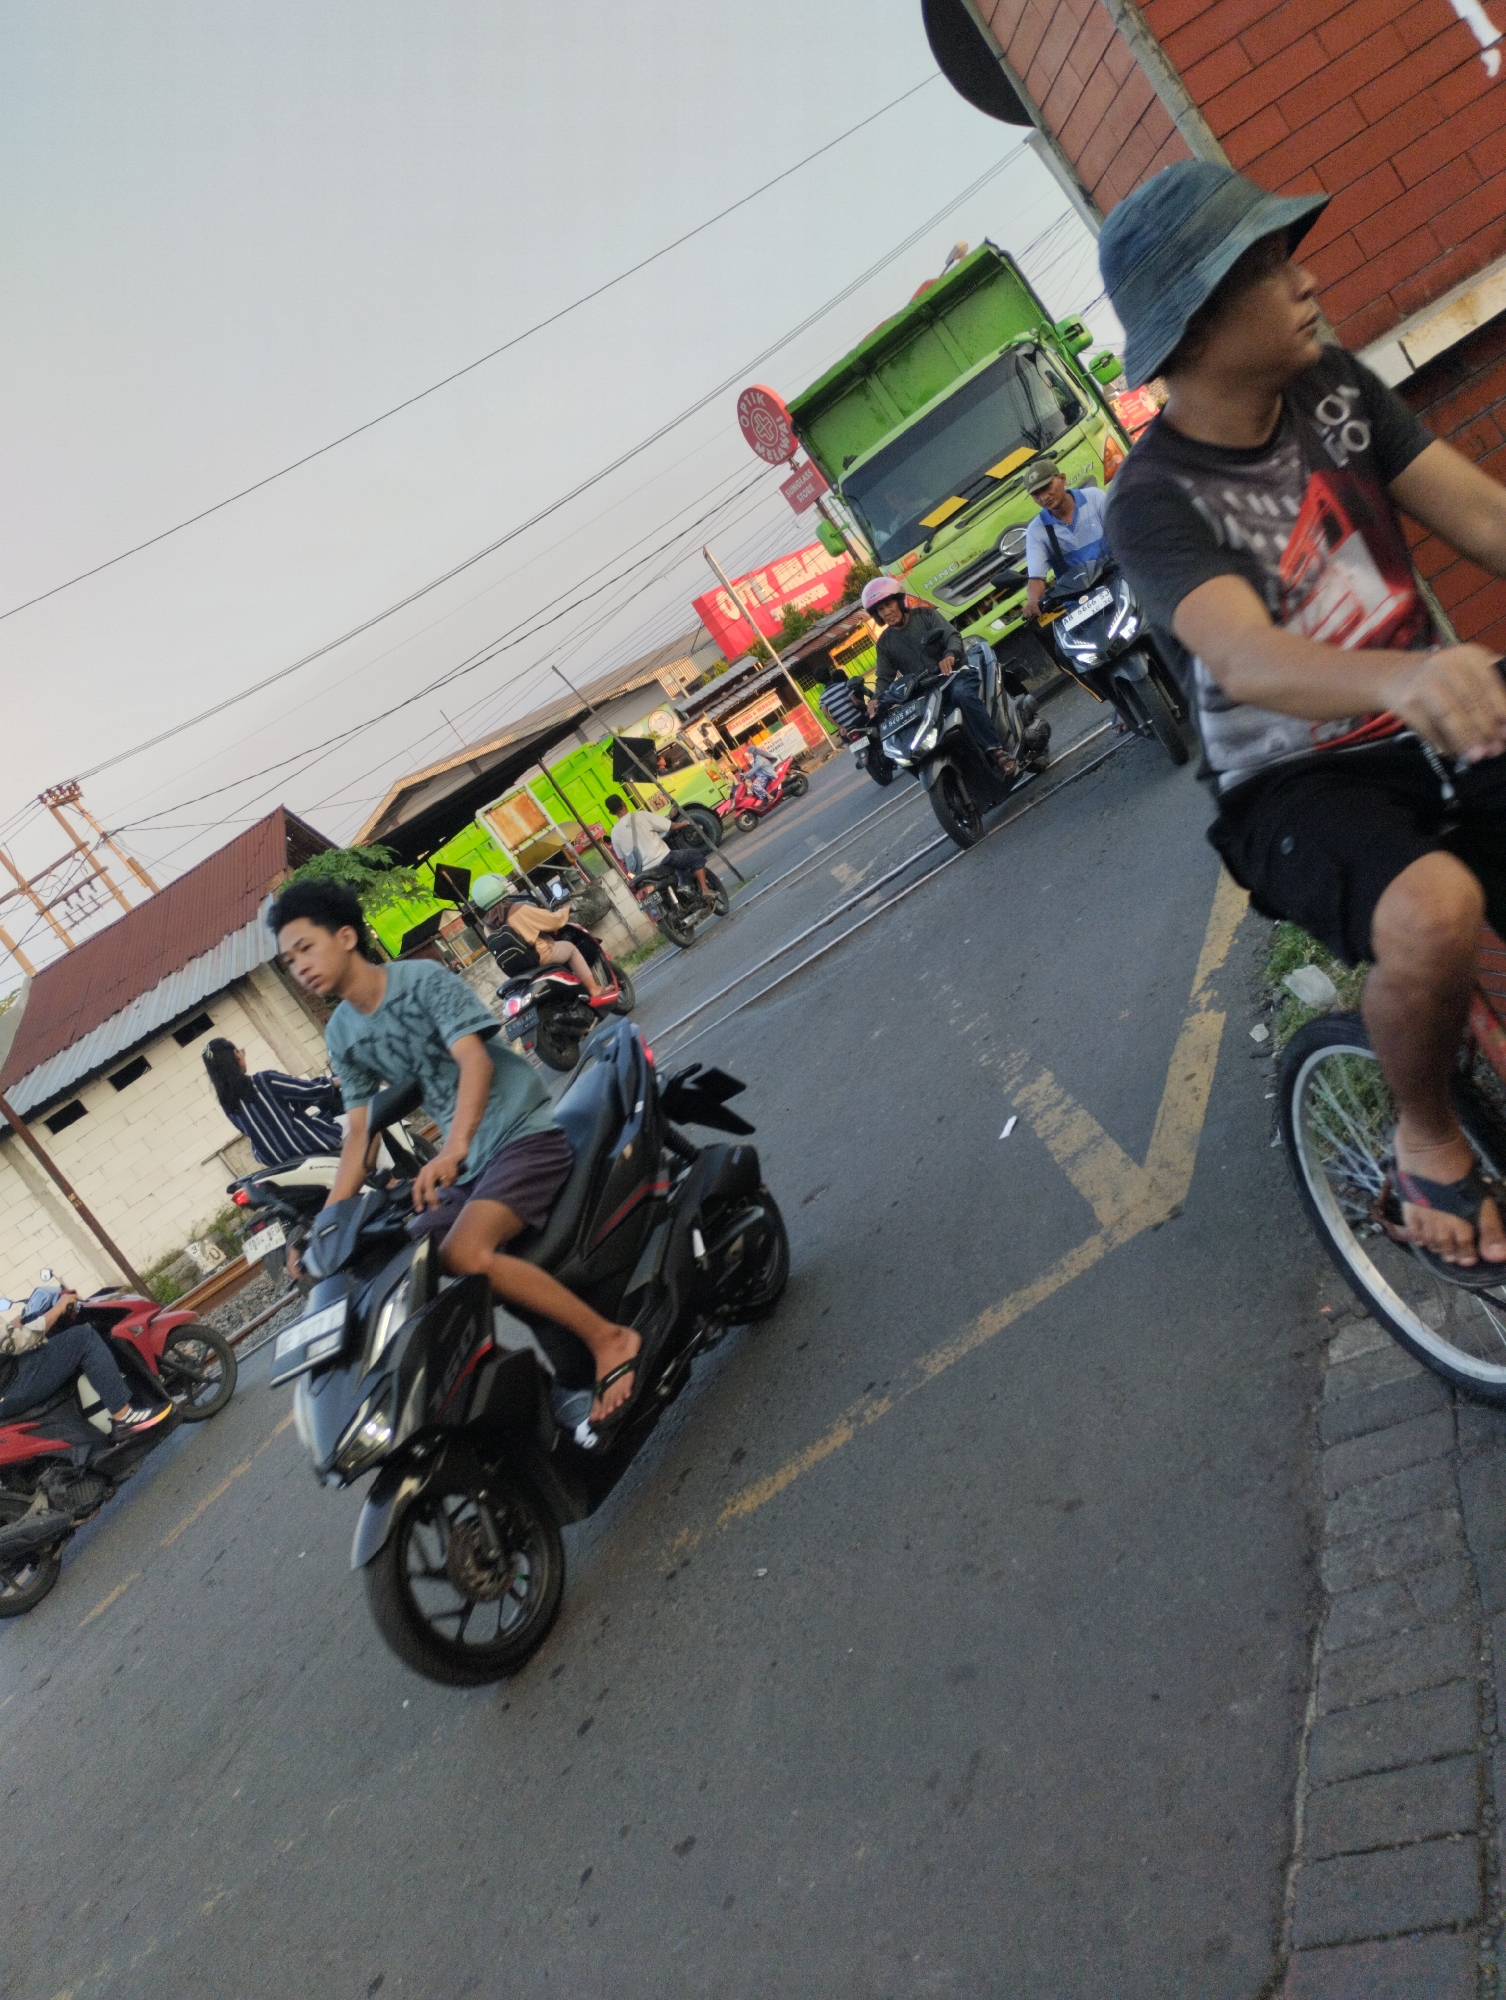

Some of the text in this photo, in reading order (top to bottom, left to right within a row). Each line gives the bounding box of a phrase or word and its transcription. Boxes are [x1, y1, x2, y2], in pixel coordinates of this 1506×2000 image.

[740, 392, 766, 428] OPTIK
[755, 415, 790, 461] MELAWAI
[785, 468, 814, 498] SUNGLASS
[796, 483, 815, 503] STORE
[924, 560, 960, 590] HINO
[1077, 599, 1097, 615] 6666
